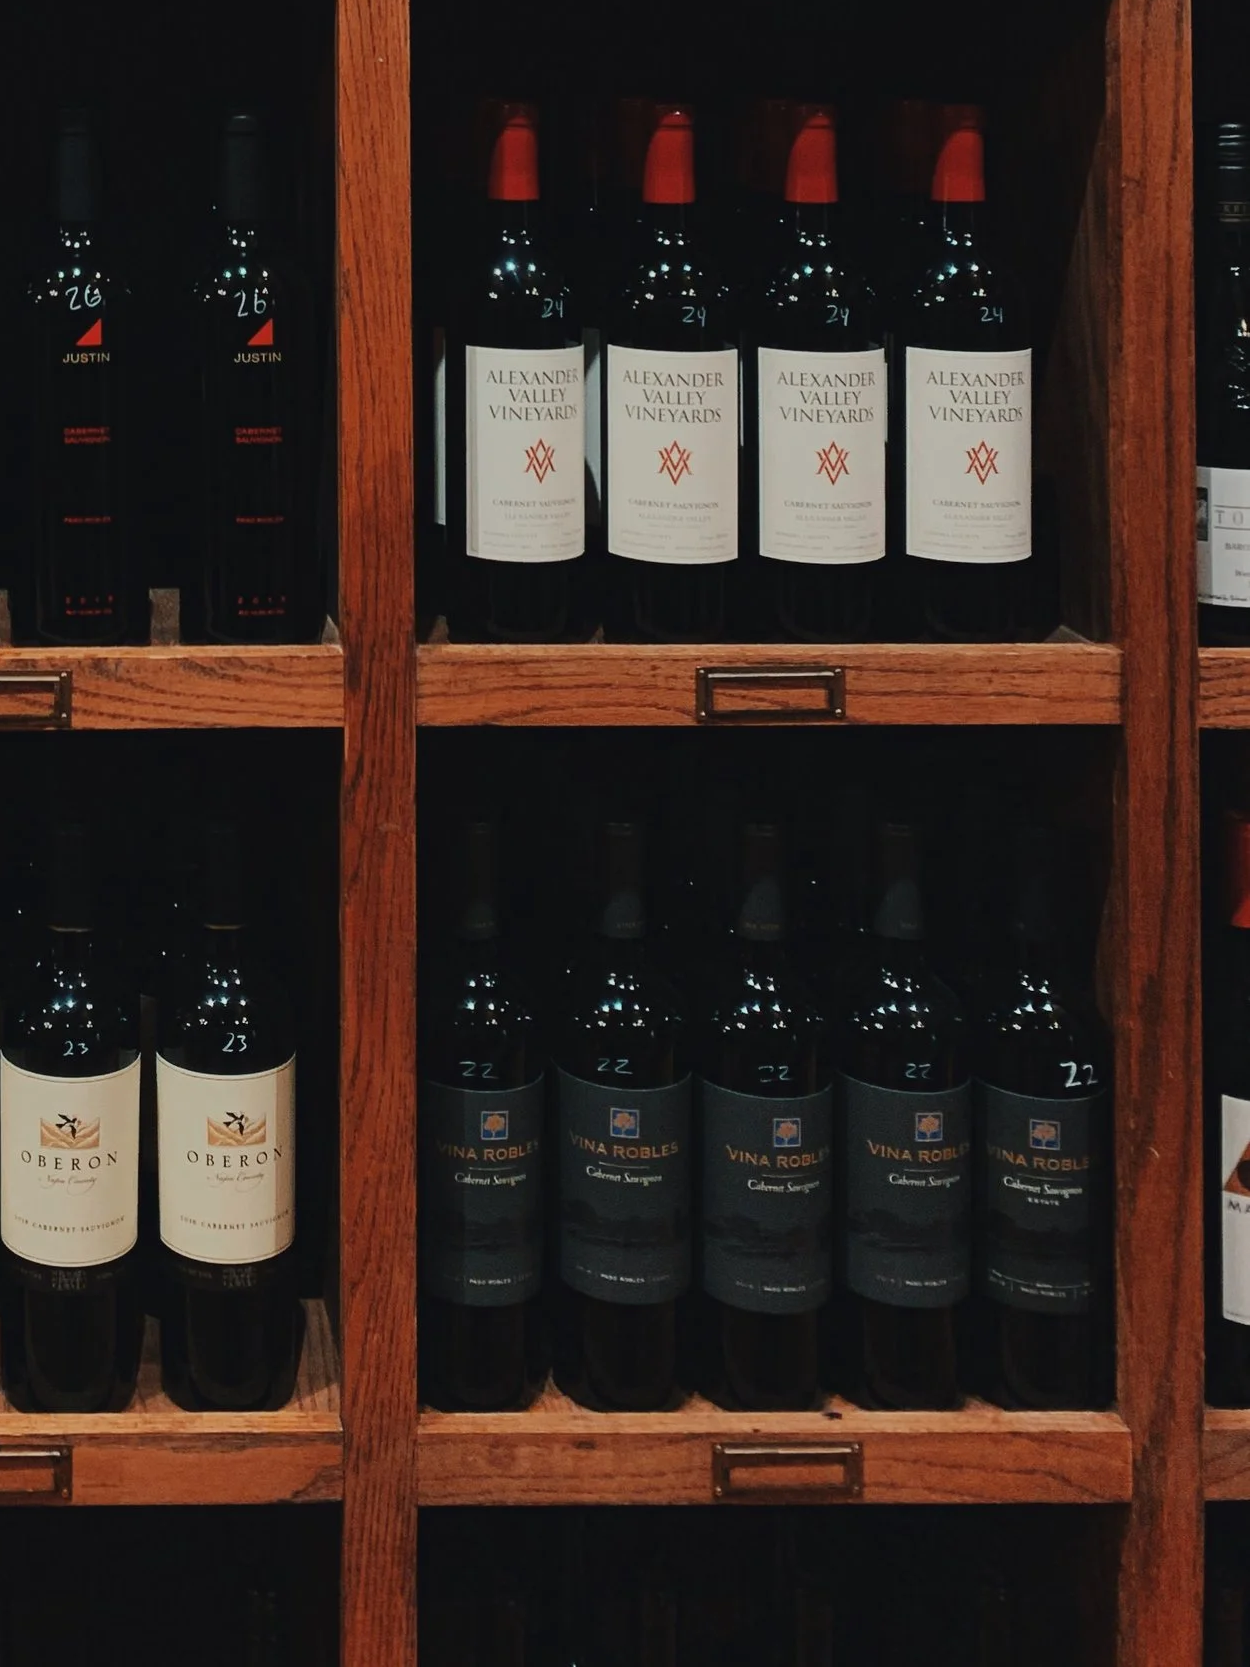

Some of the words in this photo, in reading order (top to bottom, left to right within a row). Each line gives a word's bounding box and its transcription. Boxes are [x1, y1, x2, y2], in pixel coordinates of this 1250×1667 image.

[65, 285, 103, 311] 26
[235, 289, 267, 317] 26
[980, 306, 1003, 323] 24
[62, 352, 110, 364] JUSTIN
[234, 352, 282, 364] JUSTIN
[486, 369, 579, 385] ALEXANDER
[622, 369, 724, 387] ALEXANDER
[777, 371, 876, 387] ALEXANDER
[926, 370, 1025, 387] ALEXANDER
[508, 387, 567, 404] VALLEY
[642, 389, 707, 406] VALLEY
[799, 390, 862, 405] VALLEY
[949, 389, 1011, 405] VALLEY
[488, 404, 578, 421] VINEYARDS
[624, 404, 722, 423] VINEYARDS
[779, 406, 875, 423] VINEYARDS
[928, 406, 1023, 423] VINEYARDS
[63, 1040, 89, 1056] 23
[222, 1032, 247, 1052] 23
[1060, 1061, 1099, 1087] 22
[187, 1147, 283, 1168] OBERON
[613, 1141, 679, 1159] ROBLES
[21, 1150, 118, 1171] OBERON
